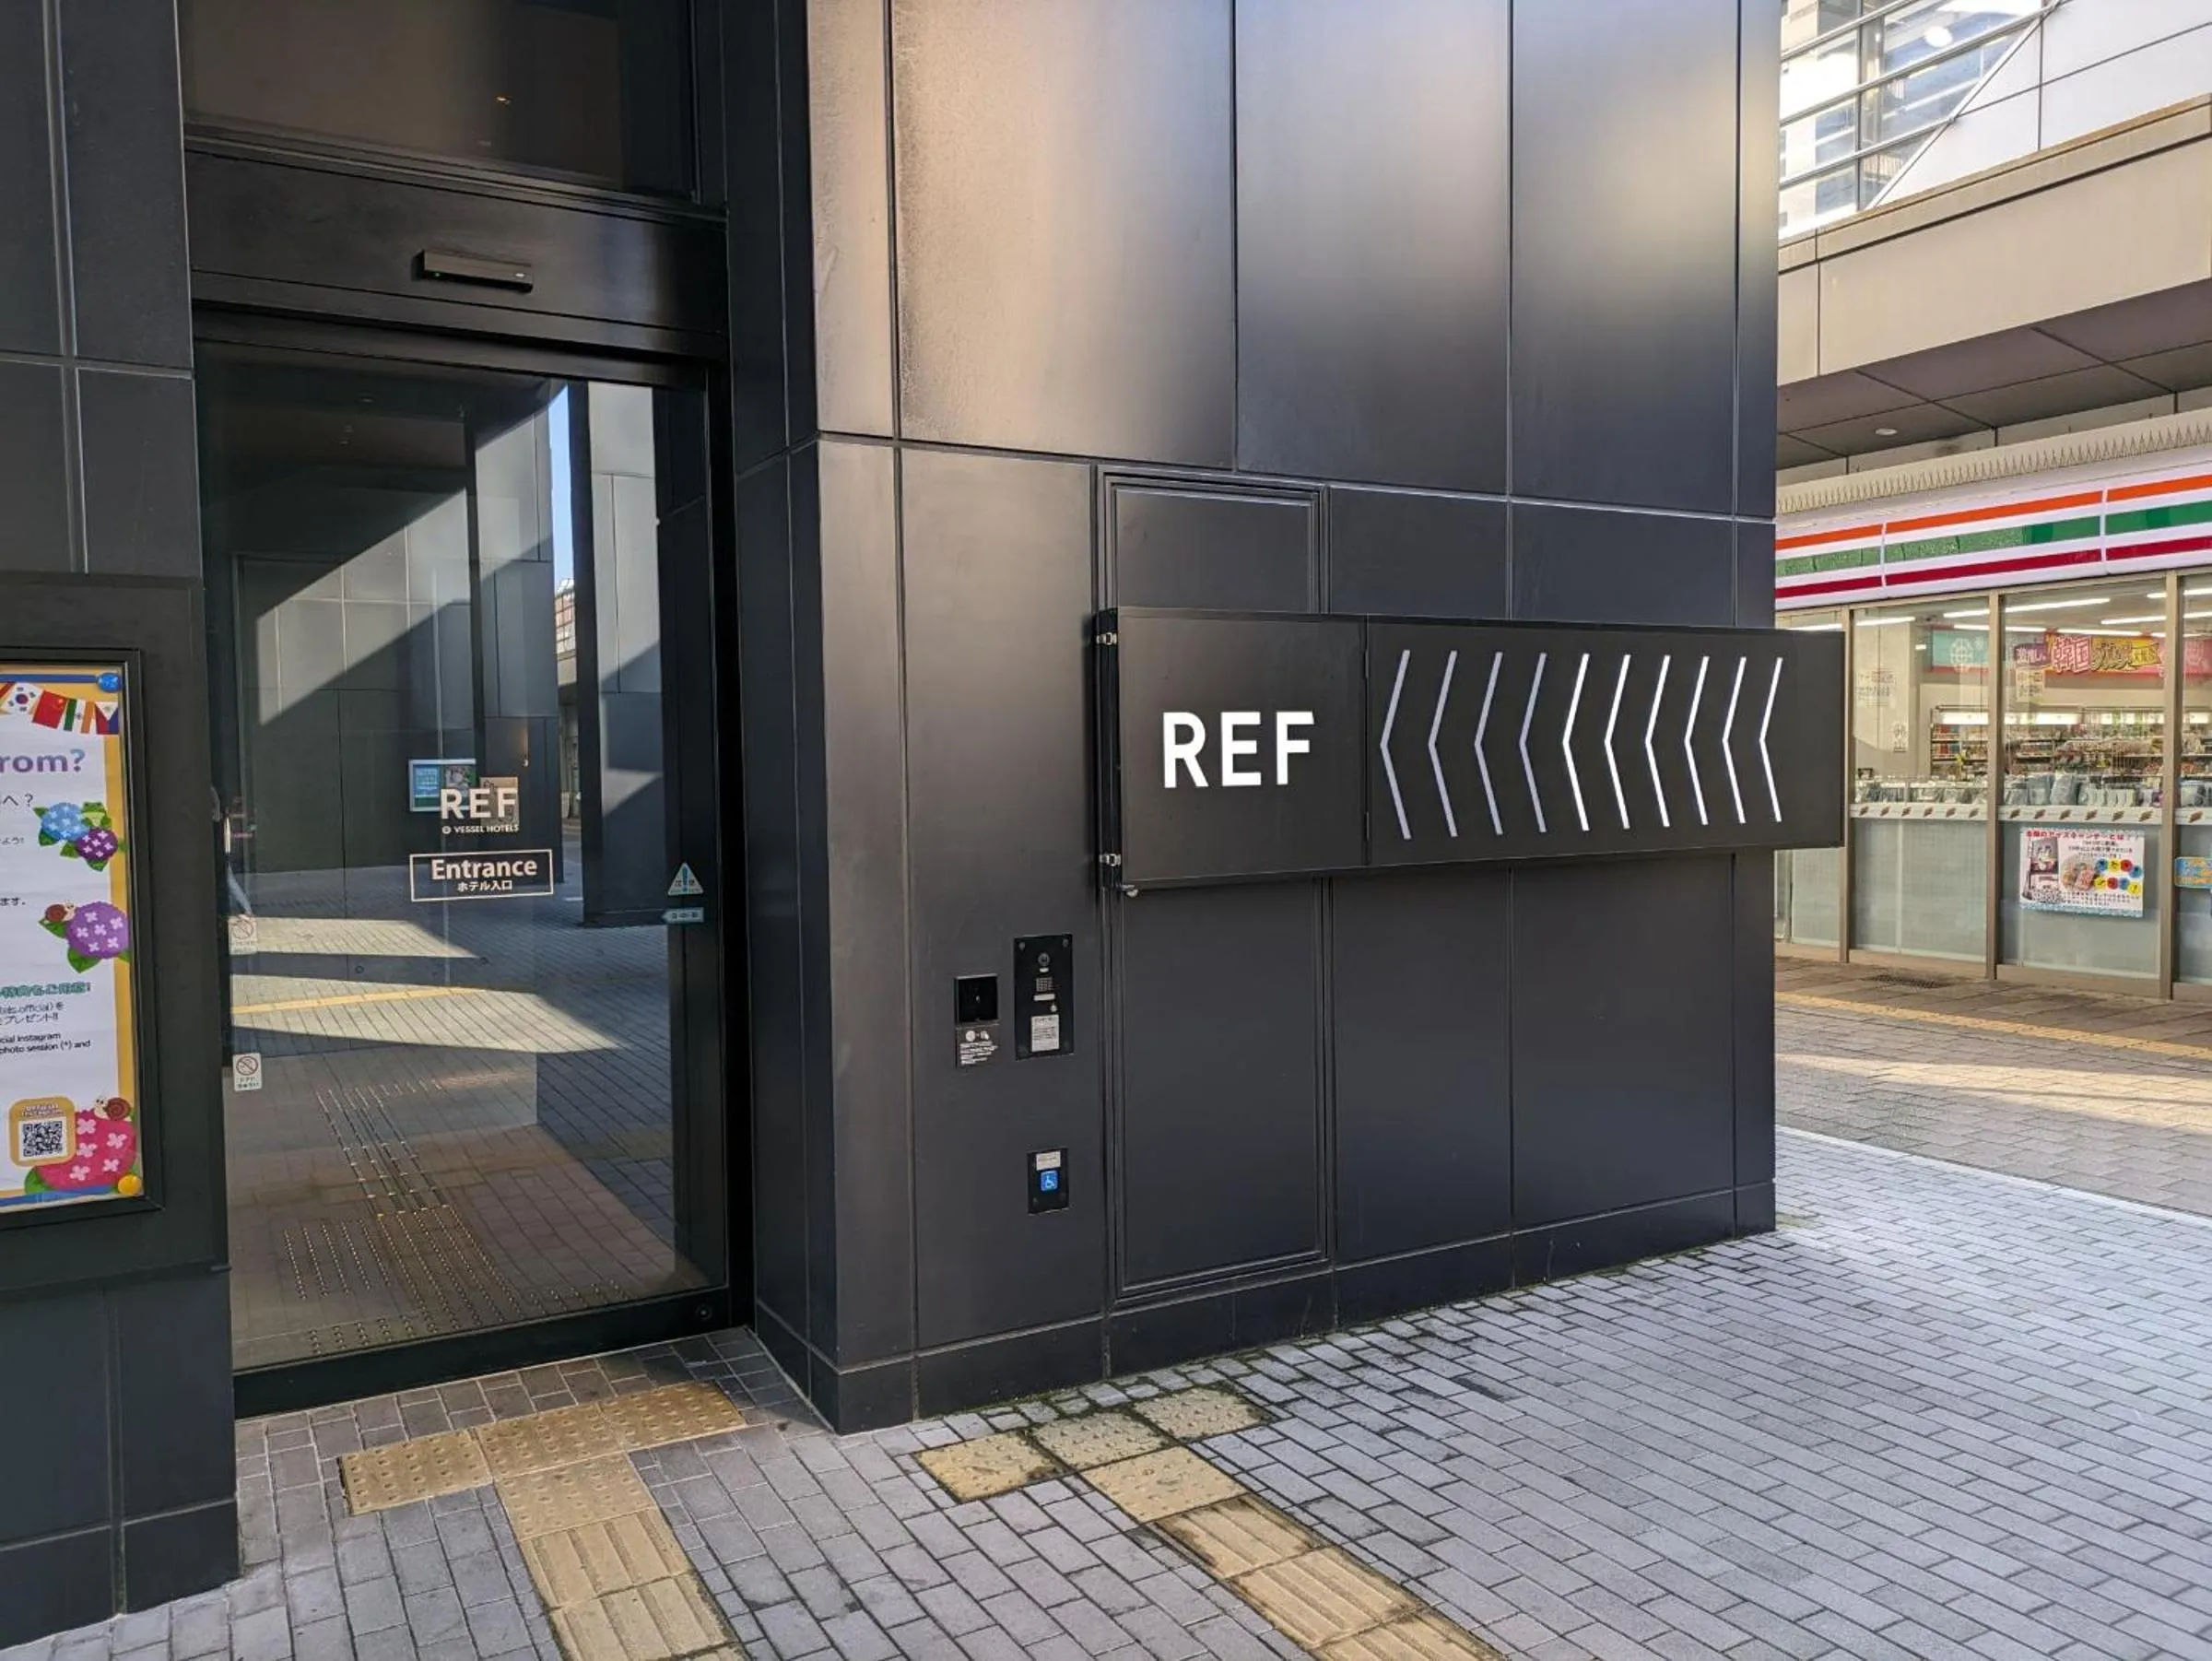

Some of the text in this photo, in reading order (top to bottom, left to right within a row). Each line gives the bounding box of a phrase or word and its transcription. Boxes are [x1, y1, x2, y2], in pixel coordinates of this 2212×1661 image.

[1162, 711, 1315, 789] REF
[441, 788, 518, 819] REF
[487, 824, 519, 832] HOTELS
[431, 858, 537, 880] Entrance
[457, 880, 512, 892] ホテル入口
[18, 1033, 61, 1042] Instagram
[74, 1040, 91, 1048] and
